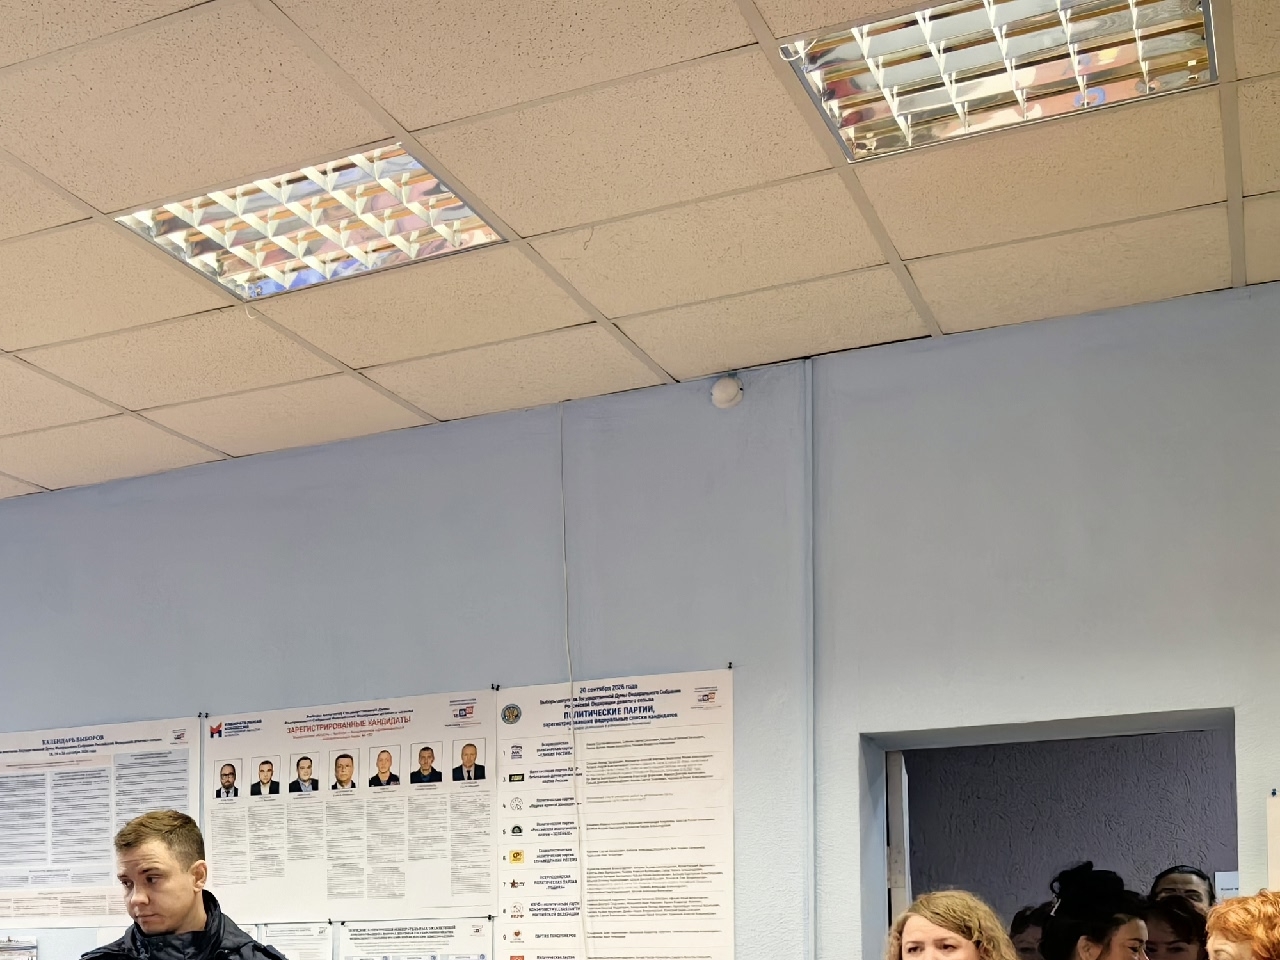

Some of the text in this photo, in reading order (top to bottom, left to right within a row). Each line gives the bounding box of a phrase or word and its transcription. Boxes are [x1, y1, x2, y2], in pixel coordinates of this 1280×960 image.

[623, 704, 655, 715] ПАРТИИ,
[287, 720, 366, 734] ЗАРЕГИСТРИРОВАННЫЕ
[368, 715, 411, 727] КАНДИДАТЫ
